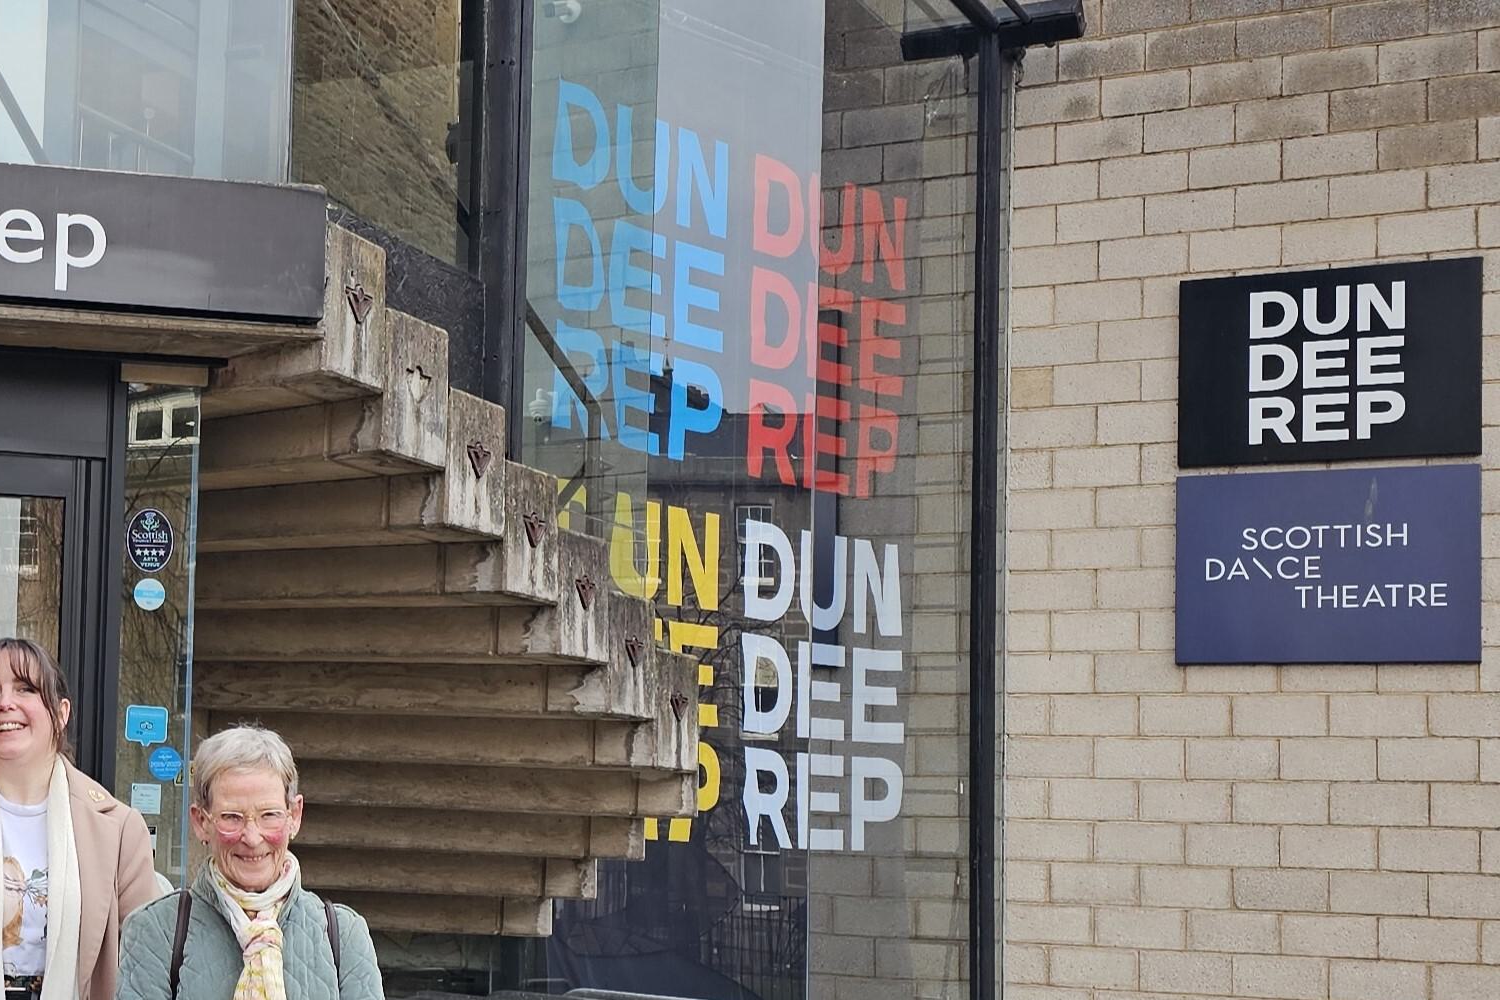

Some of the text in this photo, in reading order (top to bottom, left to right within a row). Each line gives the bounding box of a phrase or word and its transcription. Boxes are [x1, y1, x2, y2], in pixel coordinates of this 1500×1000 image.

[551, 75, 729, 240] DUN
[552, 196, 725, 354] DEE
[752, 153, 908, 291] DUN
[750, 266, 909, 398] DEE
[1248, 279, 1407, 339] DUN
[1248, 335, 1406, 392] DEE
[551, 319, 723, 462] REP
[746, 380, 899, 500] REP
[1248, 390, 1407, 446] REP
[743, 518, 903, 636] DUN
[1240, 522, 1409, 551] SCOTTISH
[1294, 582, 1448, 609] THEATRE
[740, 632, 905, 744] DEE
[741, 745, 904, 852] REP
